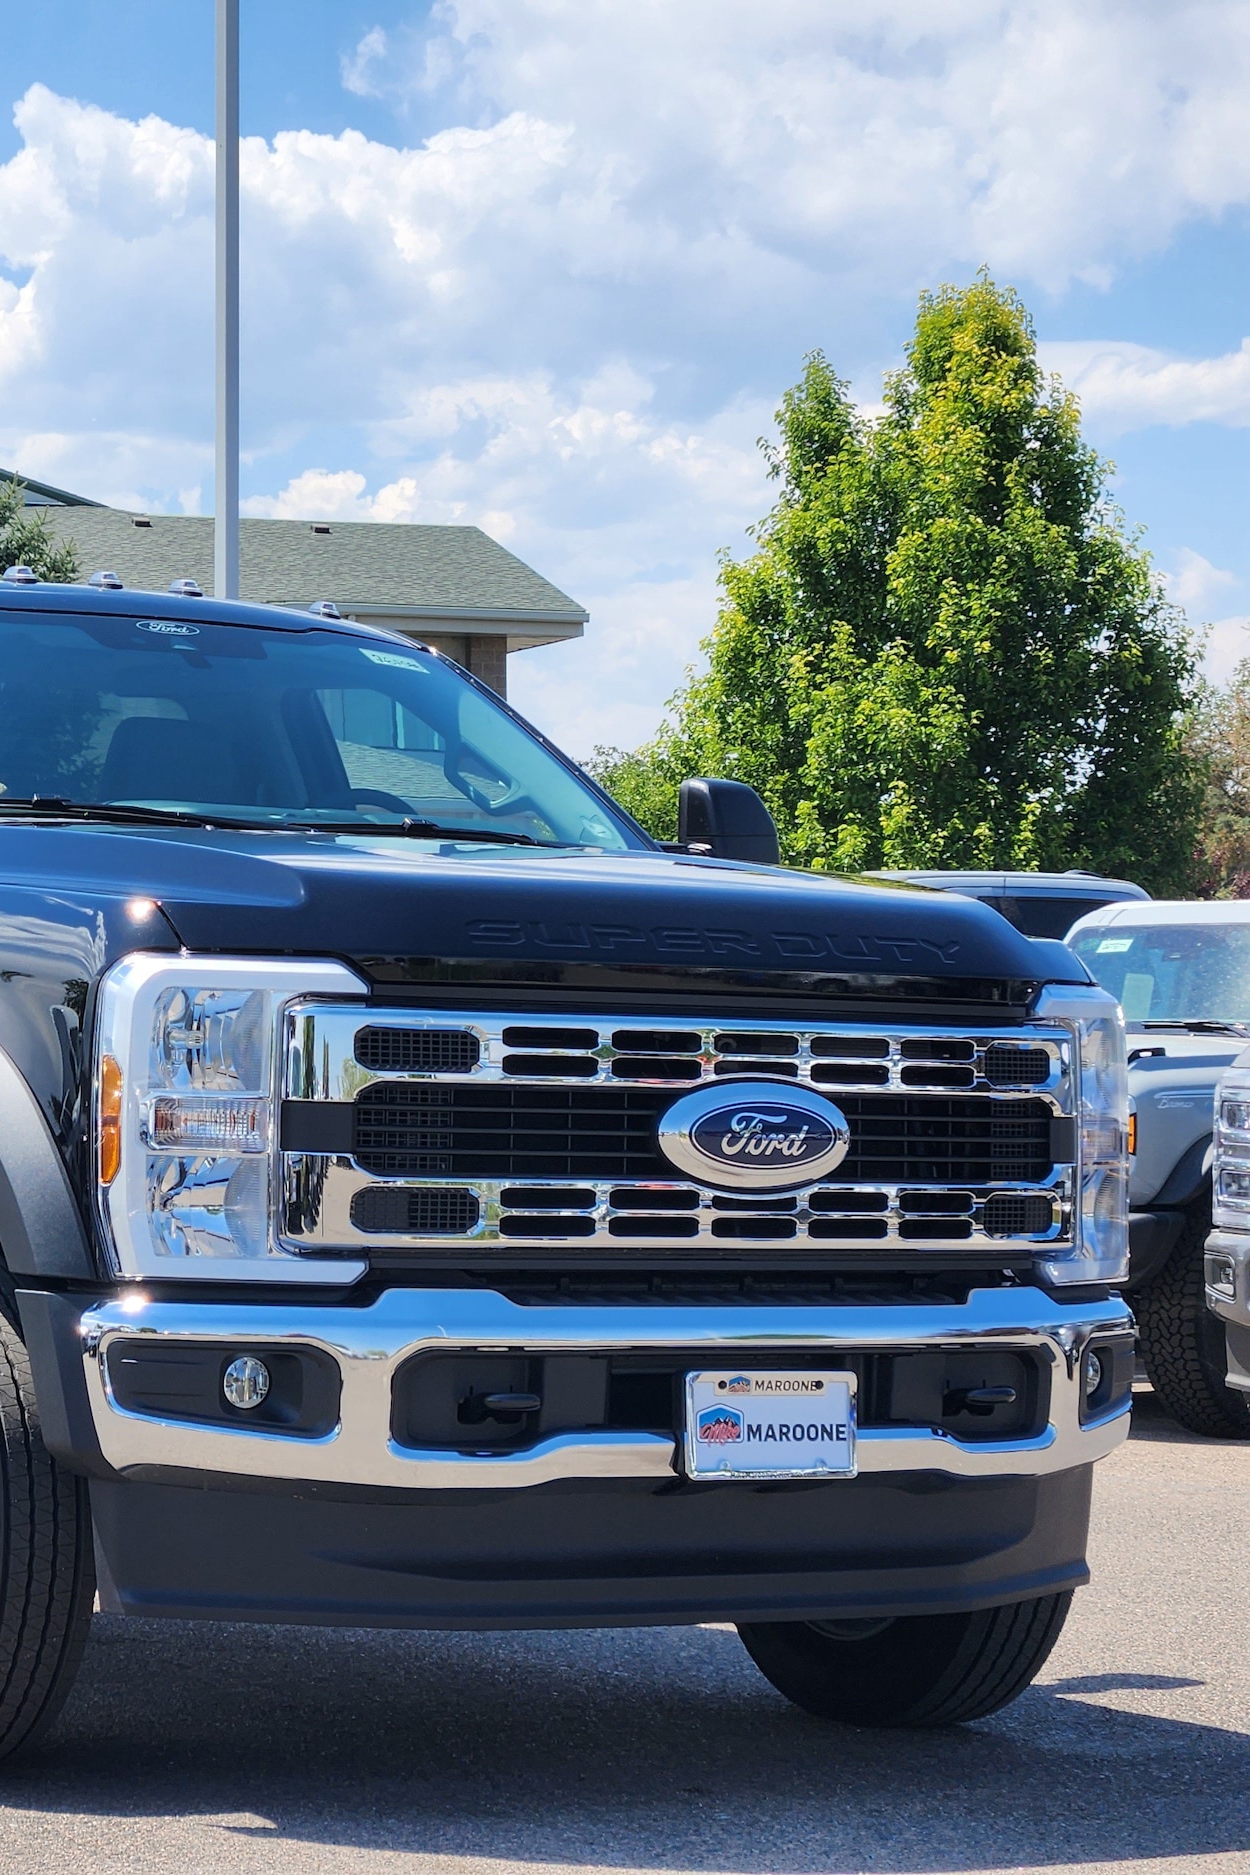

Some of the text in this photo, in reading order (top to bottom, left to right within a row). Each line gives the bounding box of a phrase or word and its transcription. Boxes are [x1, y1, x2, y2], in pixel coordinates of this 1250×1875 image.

[148, 622, 190, 633] Ford
[464, 917, 961, 965] SUPER DUTY
[720, 1112, 810, 1157] Ford
[754, 1379, 819, 1392] MAROONE
[746, 1423, 847, 1442] MAROONE
